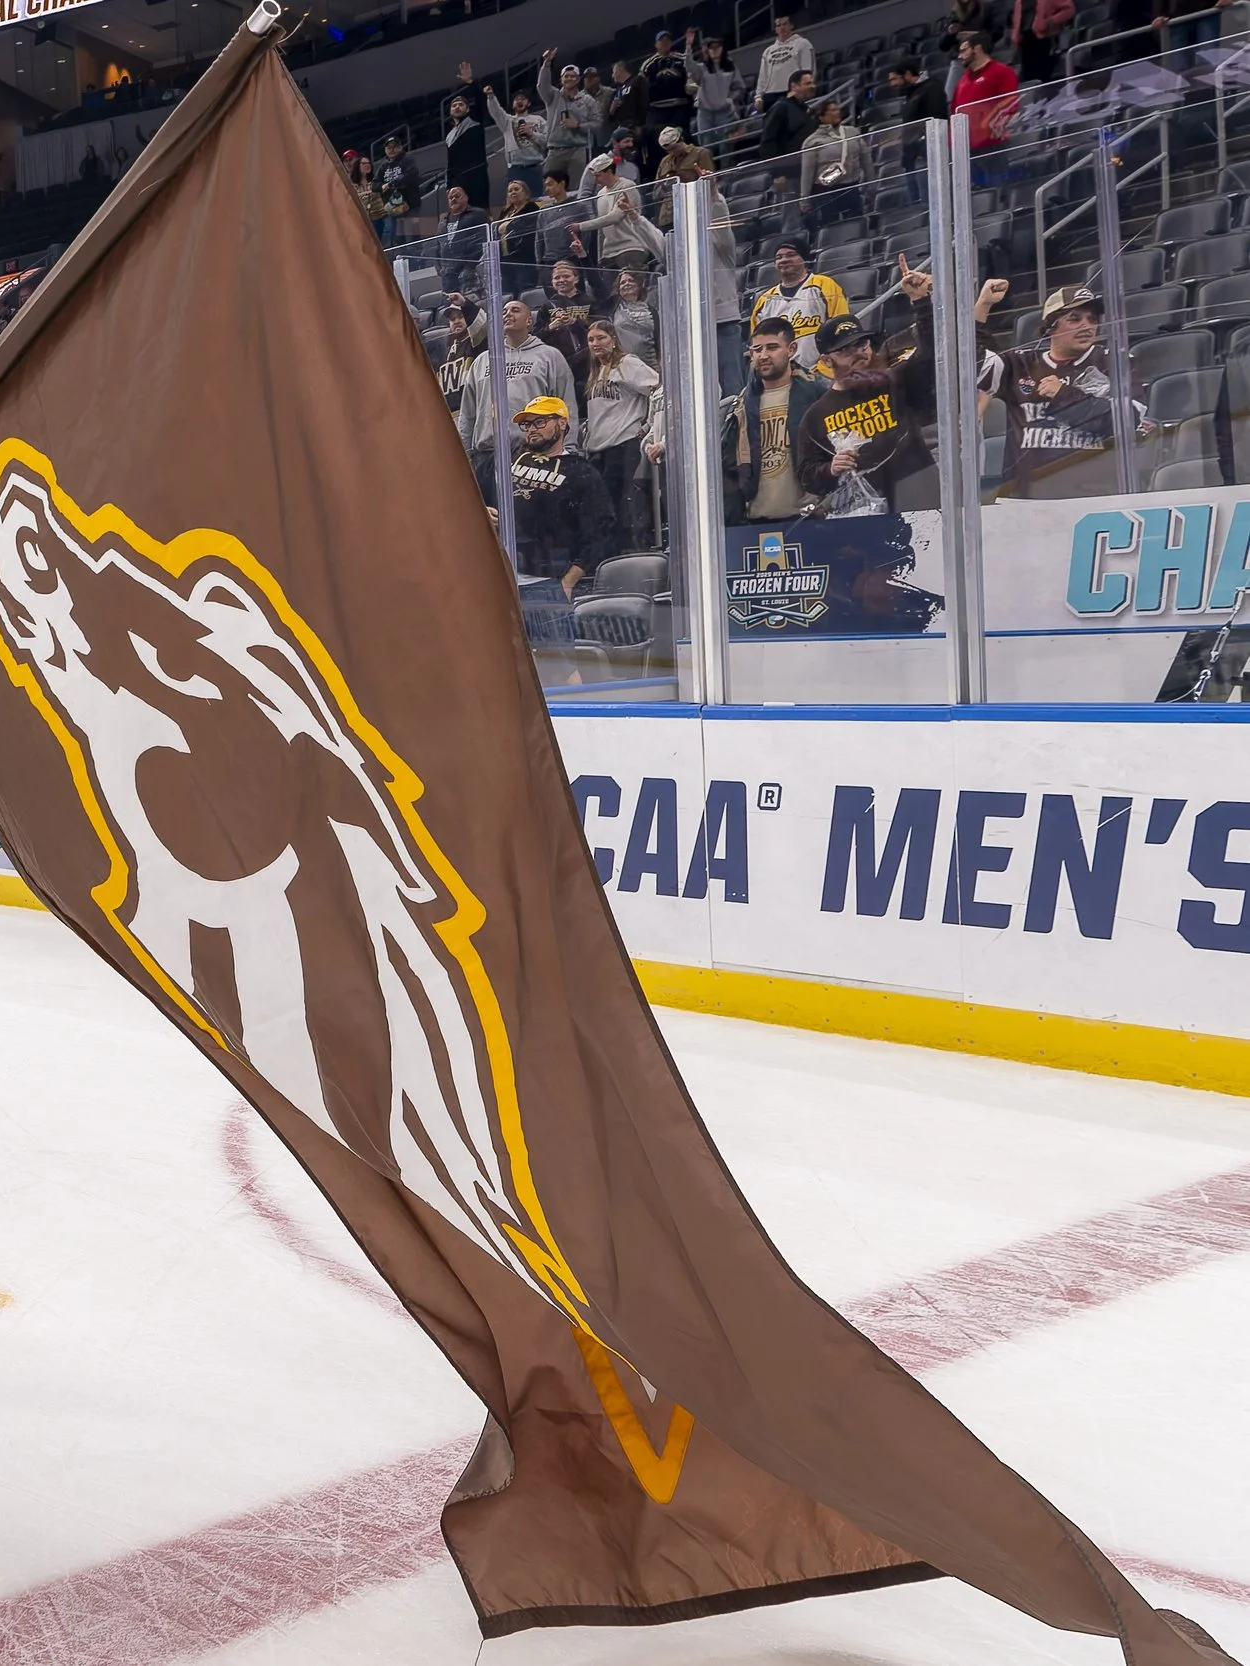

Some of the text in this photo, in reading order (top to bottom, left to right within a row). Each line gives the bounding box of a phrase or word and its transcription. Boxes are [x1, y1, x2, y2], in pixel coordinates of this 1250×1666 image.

[824, 394, 891, 433] HOCKEY
[511, 464, 566, 486] WMU
[732, 575, 820, 595] FROZEN FOUR
[820, 784, 1250, 955] MEN'S
